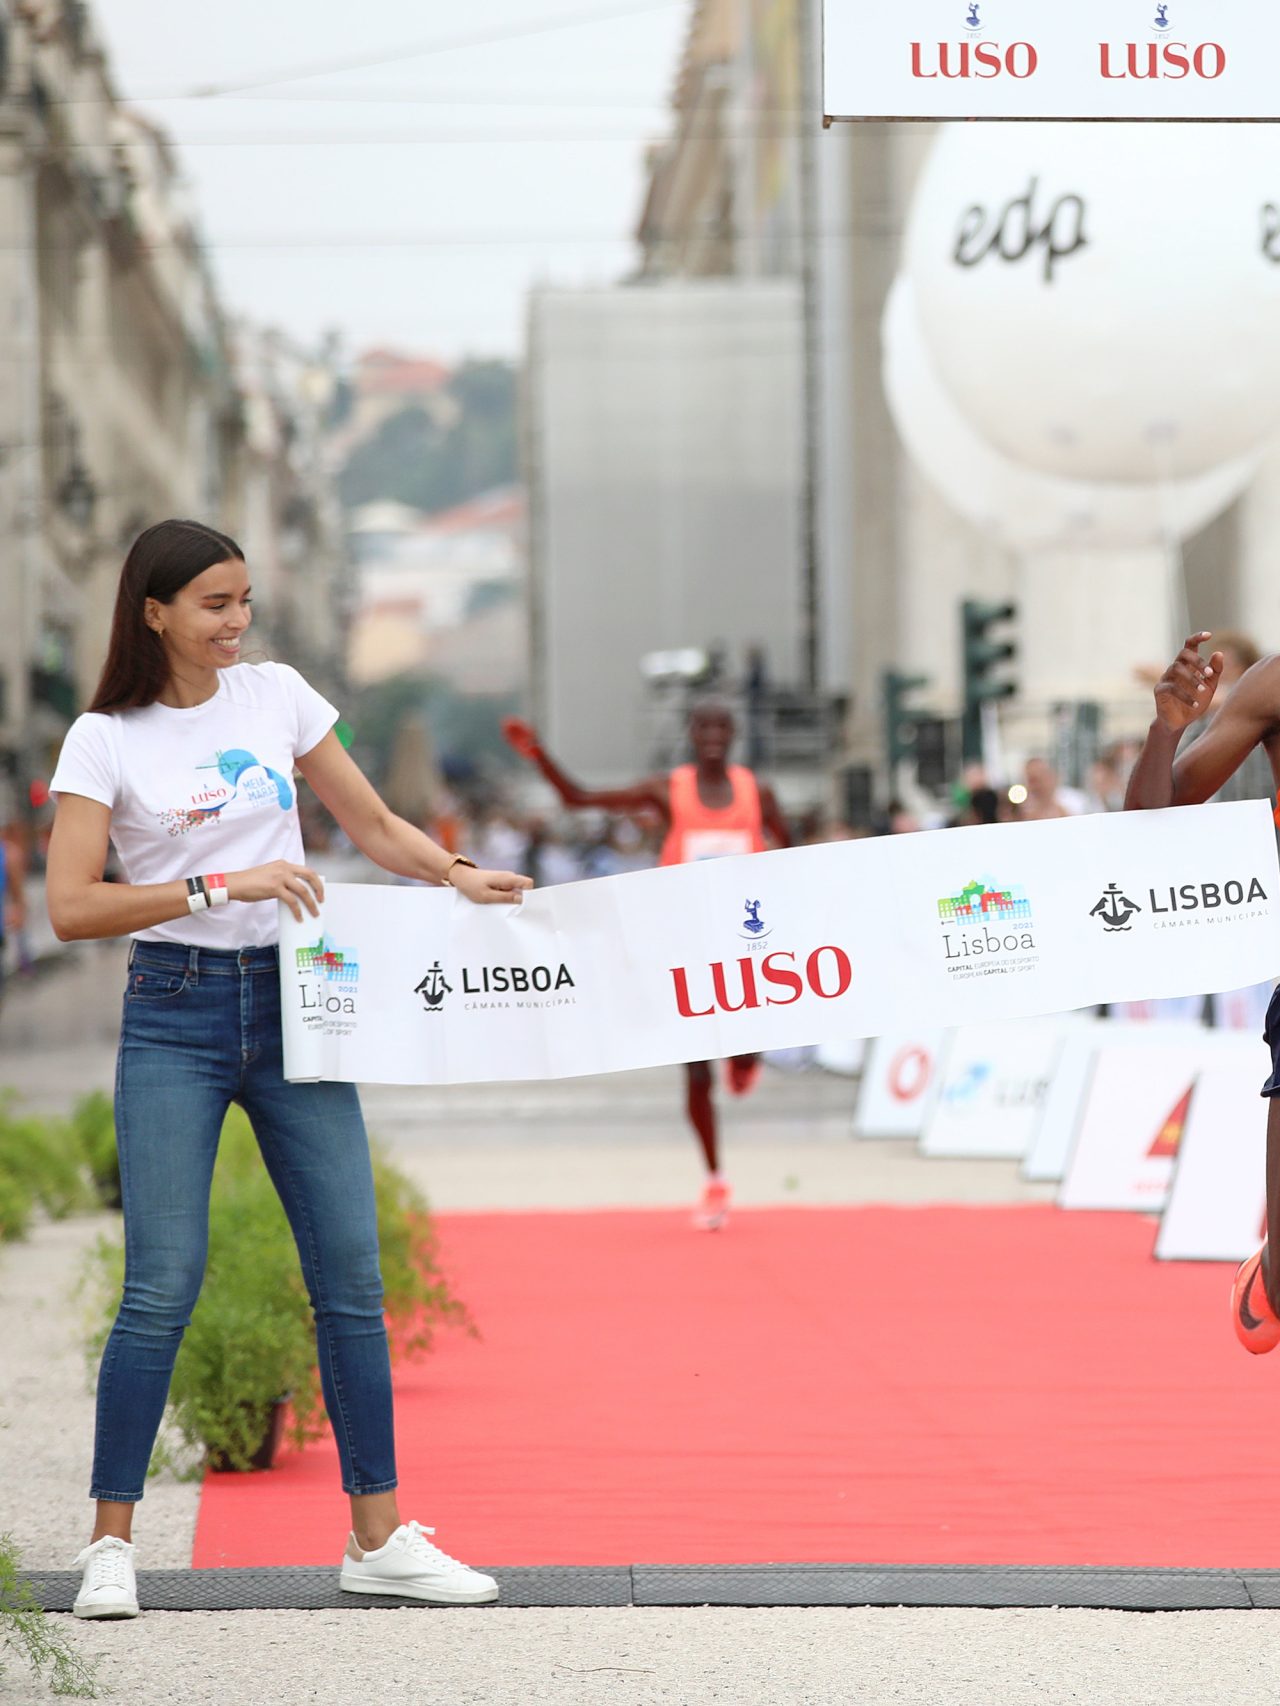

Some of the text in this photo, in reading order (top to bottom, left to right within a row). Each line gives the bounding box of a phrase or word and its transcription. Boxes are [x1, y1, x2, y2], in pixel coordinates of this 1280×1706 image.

[910, 42, 1037, 79] LUSO
[1099, 42, 1226, 79] LUSO
[952, 175, 1090, 284] edp
[191, 788, 227, 804] LUSO
[1149, 877, 1268, 913] LISBOA
[1206, 908, 1269, 924] MUNICIPAL
[746, 940, 768, 951] 1852
[942, 927, 1035, 958] Lisboa
[462, 963, 576, 993] LISBOA
[669, 946, 852, 1018] LUSO
[516, 997, 577, 1008] MUNICIPAL
